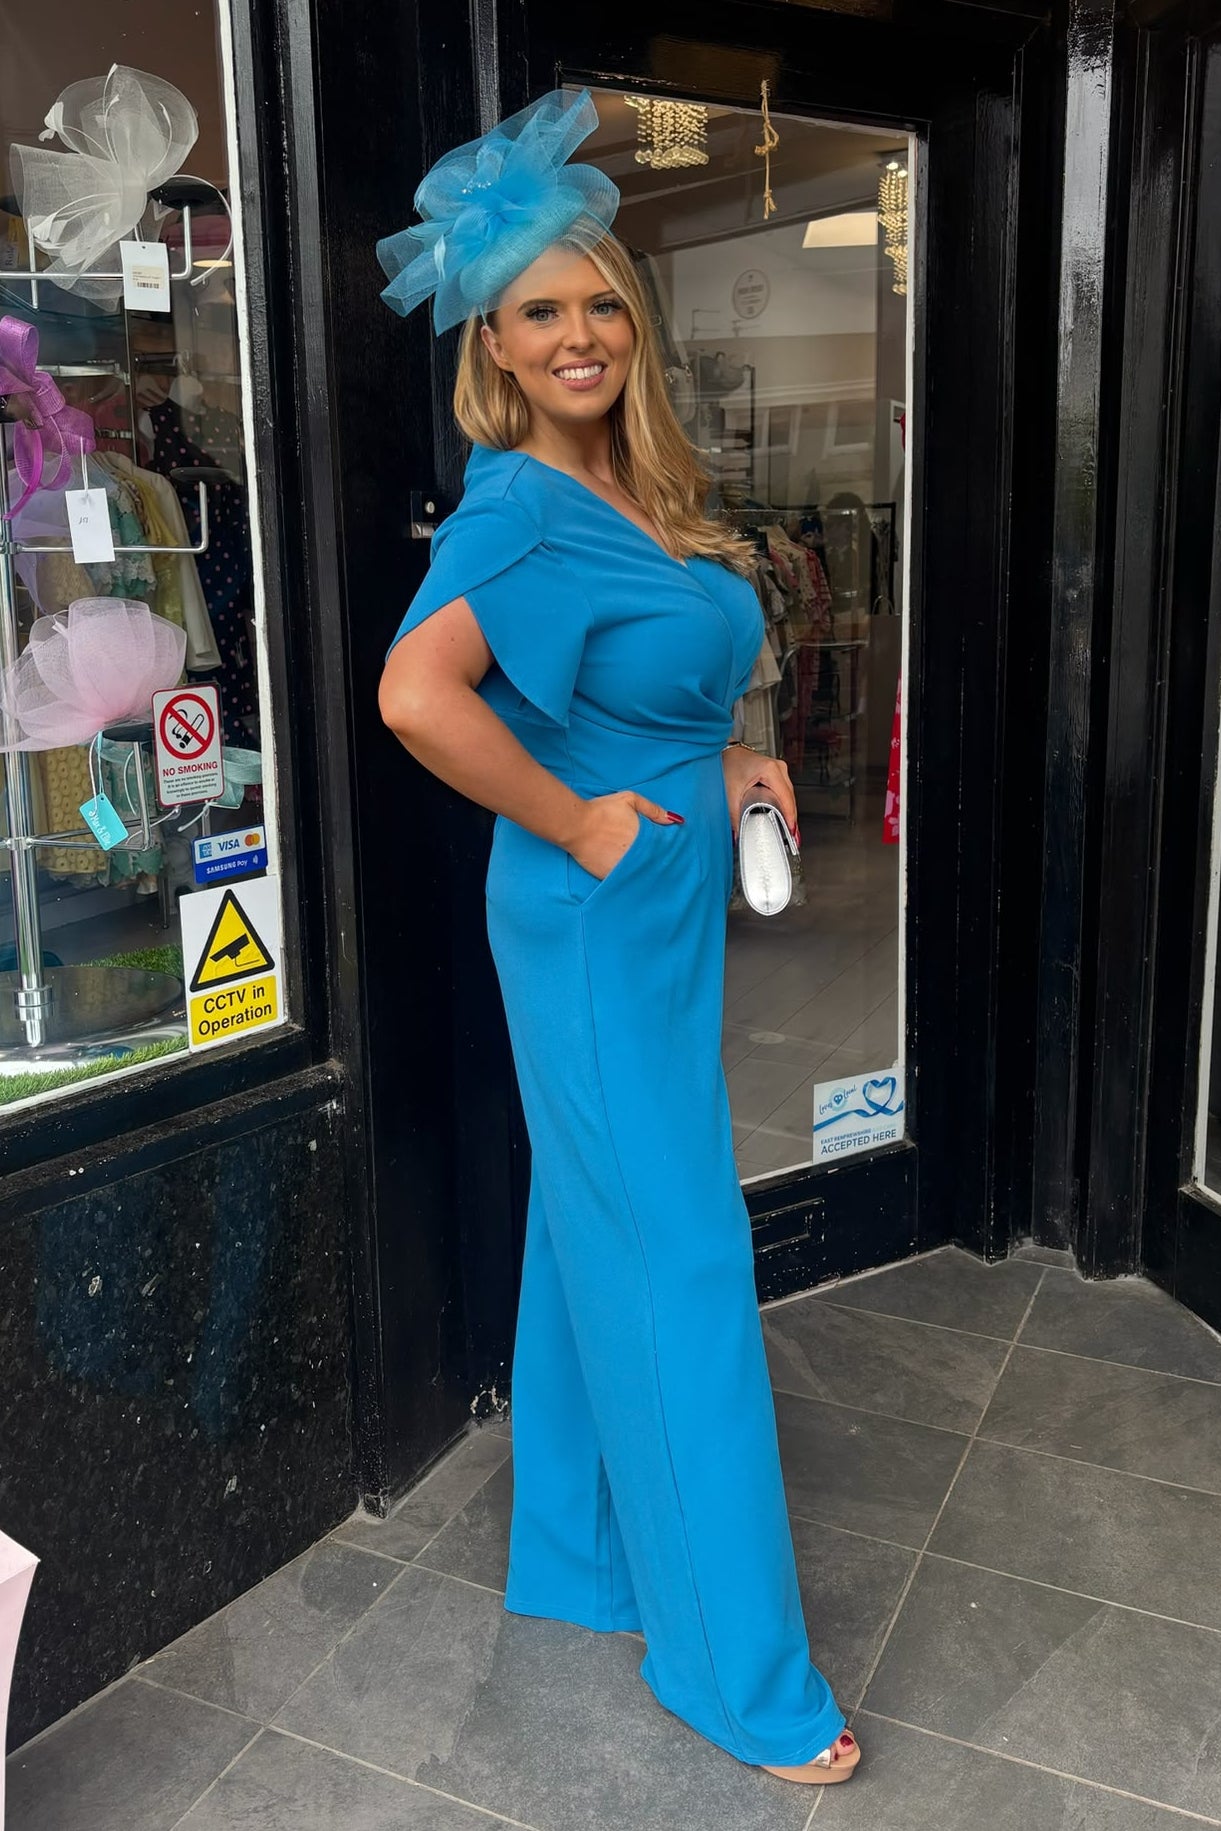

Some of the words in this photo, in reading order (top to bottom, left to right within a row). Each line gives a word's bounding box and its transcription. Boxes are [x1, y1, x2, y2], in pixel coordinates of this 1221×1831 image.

[162, 768, 176, 777] NO
[178, 761, 218, 774] SMOKING
[218, 839, 240, 851] VISA
[206, 860, 236, 874] SAMSUNG
[204, 989, 246, 1013] CCTV
[252, 986, 264, 999] in
[199, 1004, 272, 1035] Operation
[821, 1136, 870, 1155] ACCEPTED
[872, 1129, 896, 1142] HERE
